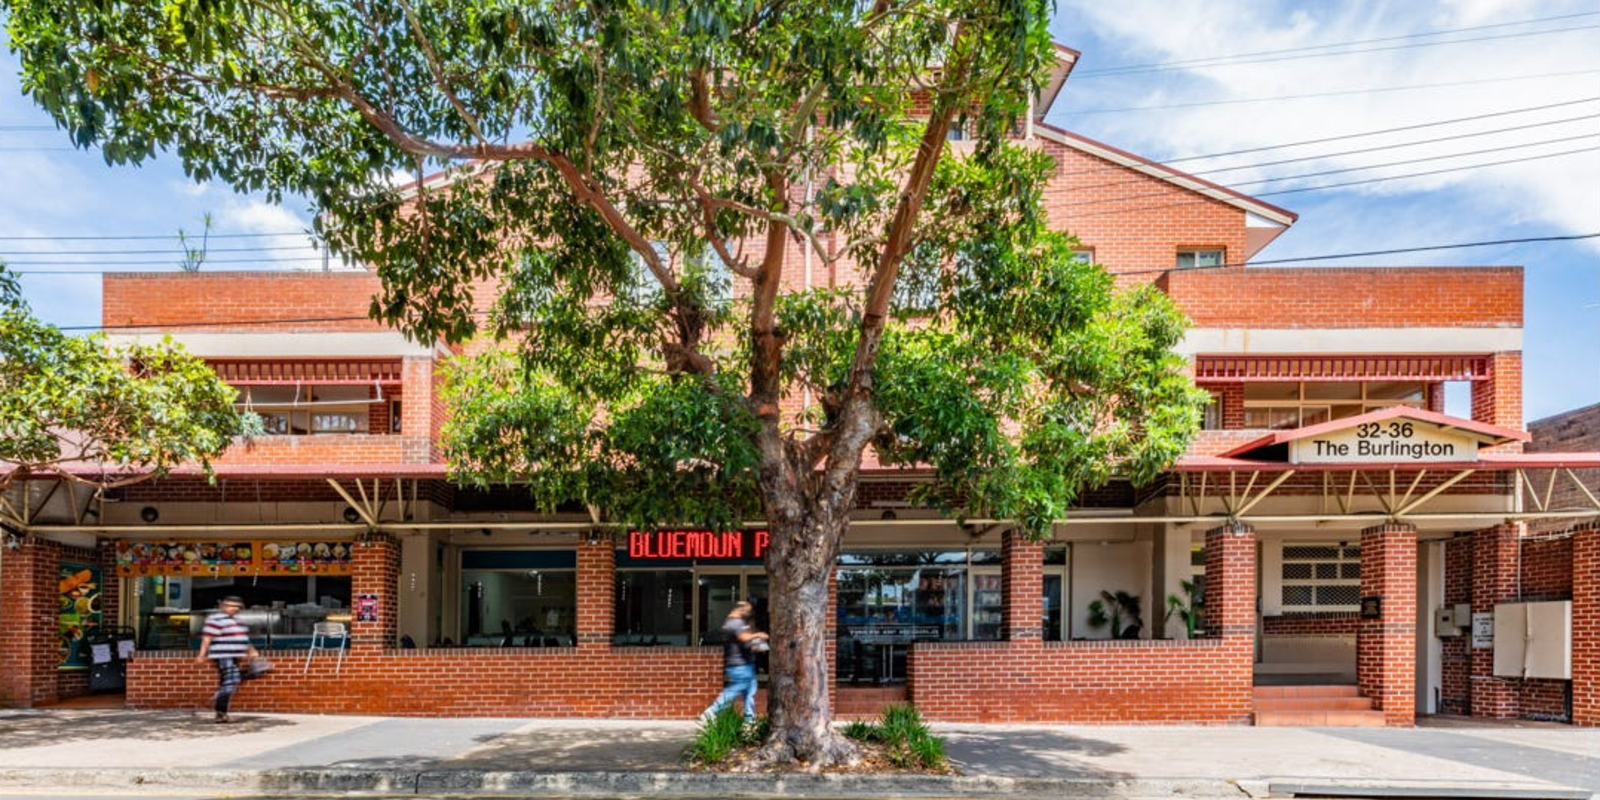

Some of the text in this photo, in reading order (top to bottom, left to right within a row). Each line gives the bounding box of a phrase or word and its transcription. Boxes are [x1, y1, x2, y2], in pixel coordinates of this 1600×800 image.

[1357, 422, 1414, 439] 32-36
[1313, 440, 1454, 459] The Burlington
[630, 531, 742, 558] BLUEMOON
